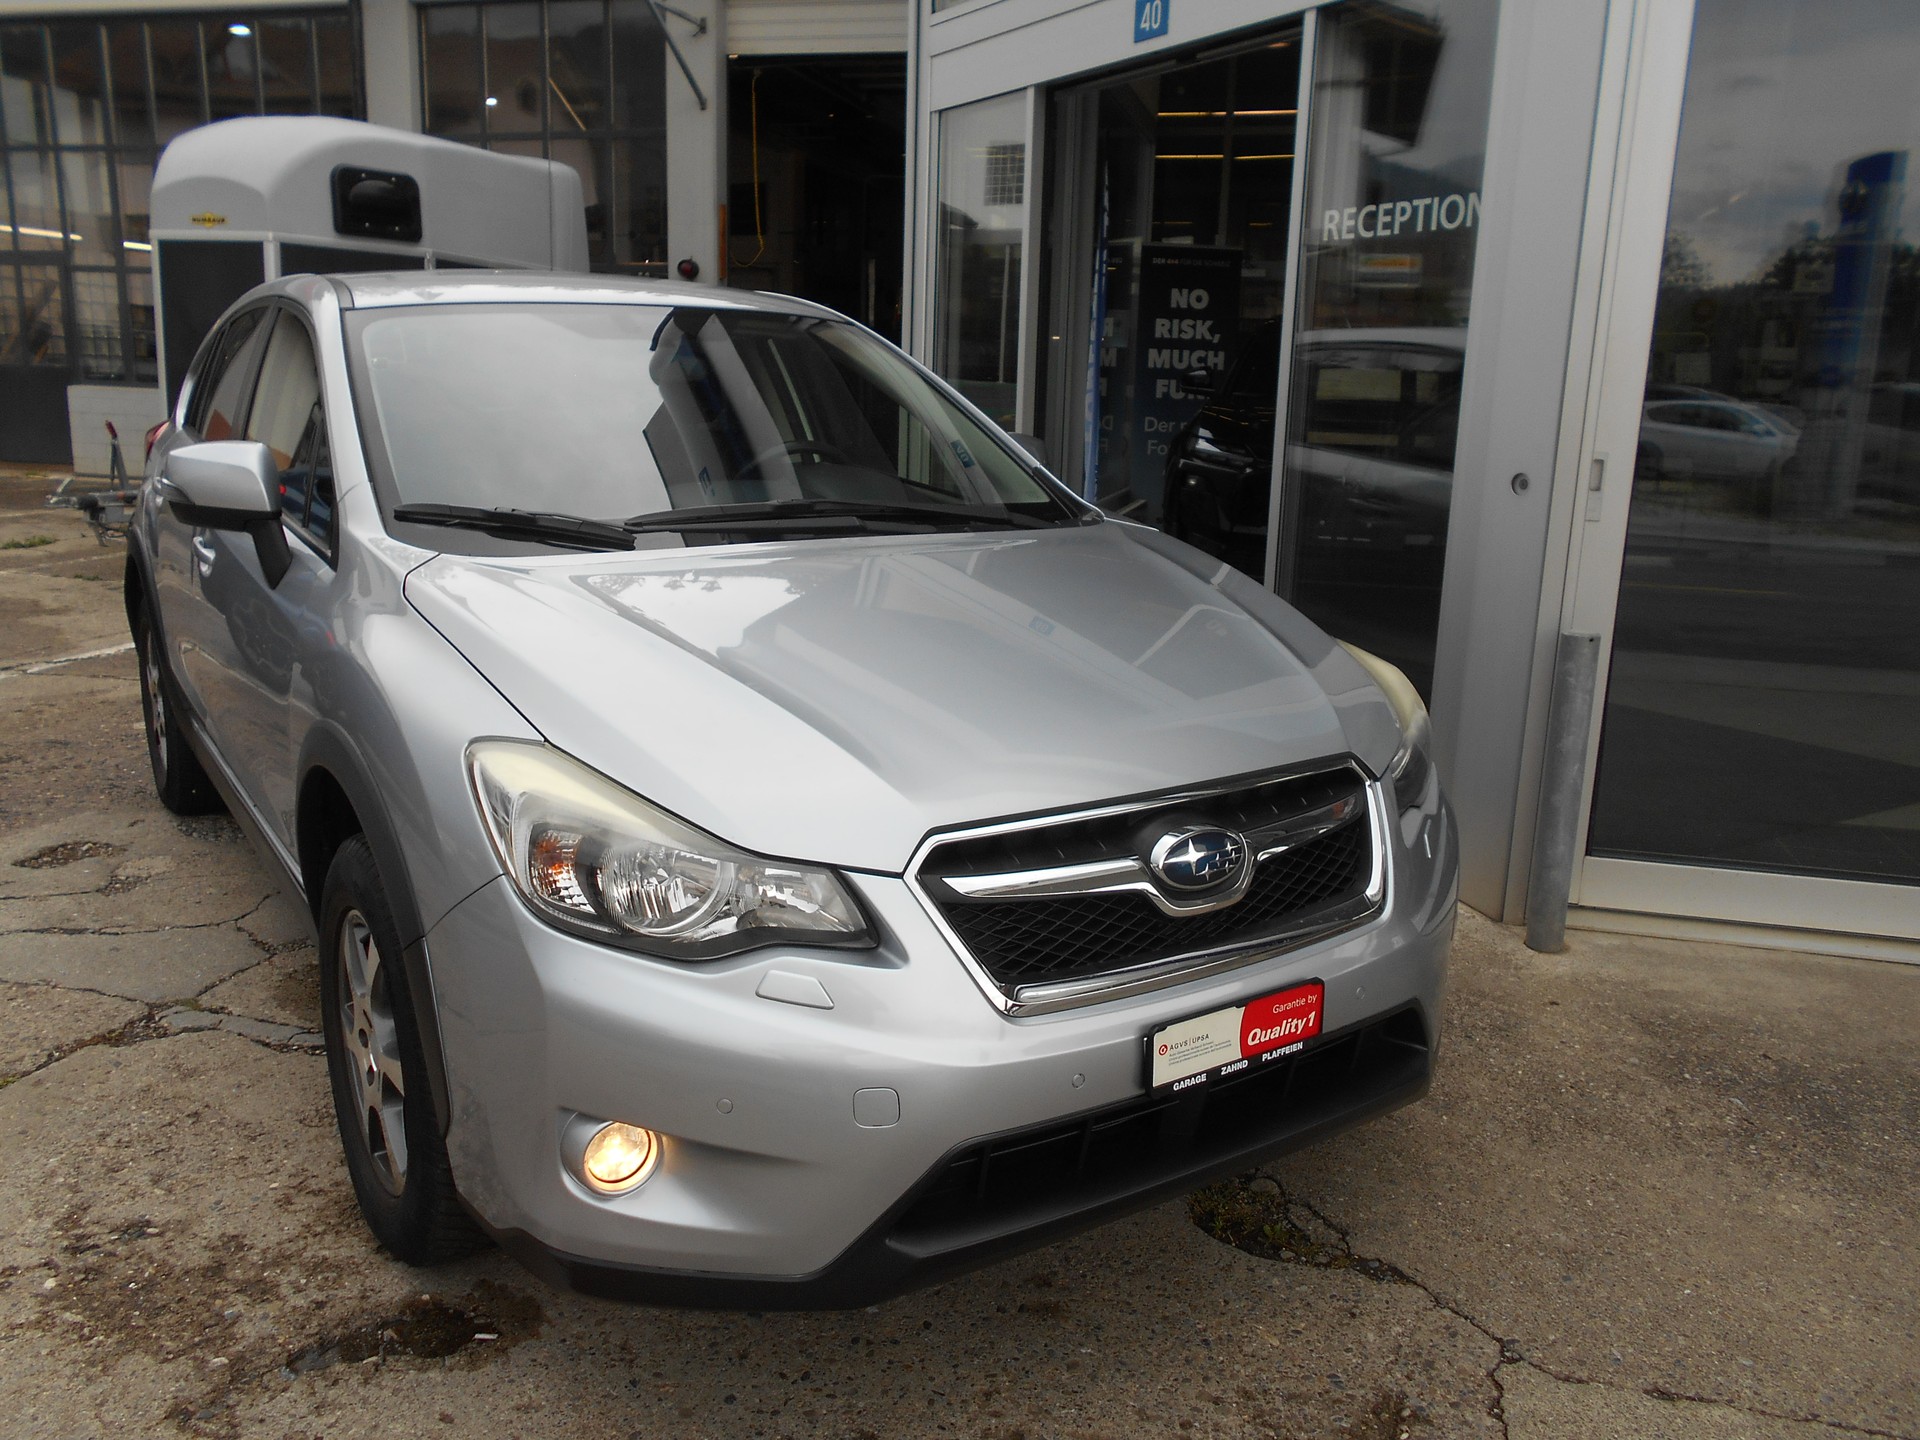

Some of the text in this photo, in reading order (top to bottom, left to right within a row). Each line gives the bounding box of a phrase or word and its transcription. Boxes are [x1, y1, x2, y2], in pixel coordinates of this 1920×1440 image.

[1140, 1, 1162, 31] 40
[1323, 192, 1482, 241] RECEPTION
[1170, 287, 1210, 310] NO
[1154, 318, 1221, 343] RISK,
[1148, 348, 1225, 371] MUCH
[1144, 416, 1175, 433] Der
[1272, 994, 1318, 1014] Garantie by
[1173, 1041, 1304, 1091] GARAGE ZAHND PLAFFEIEN
